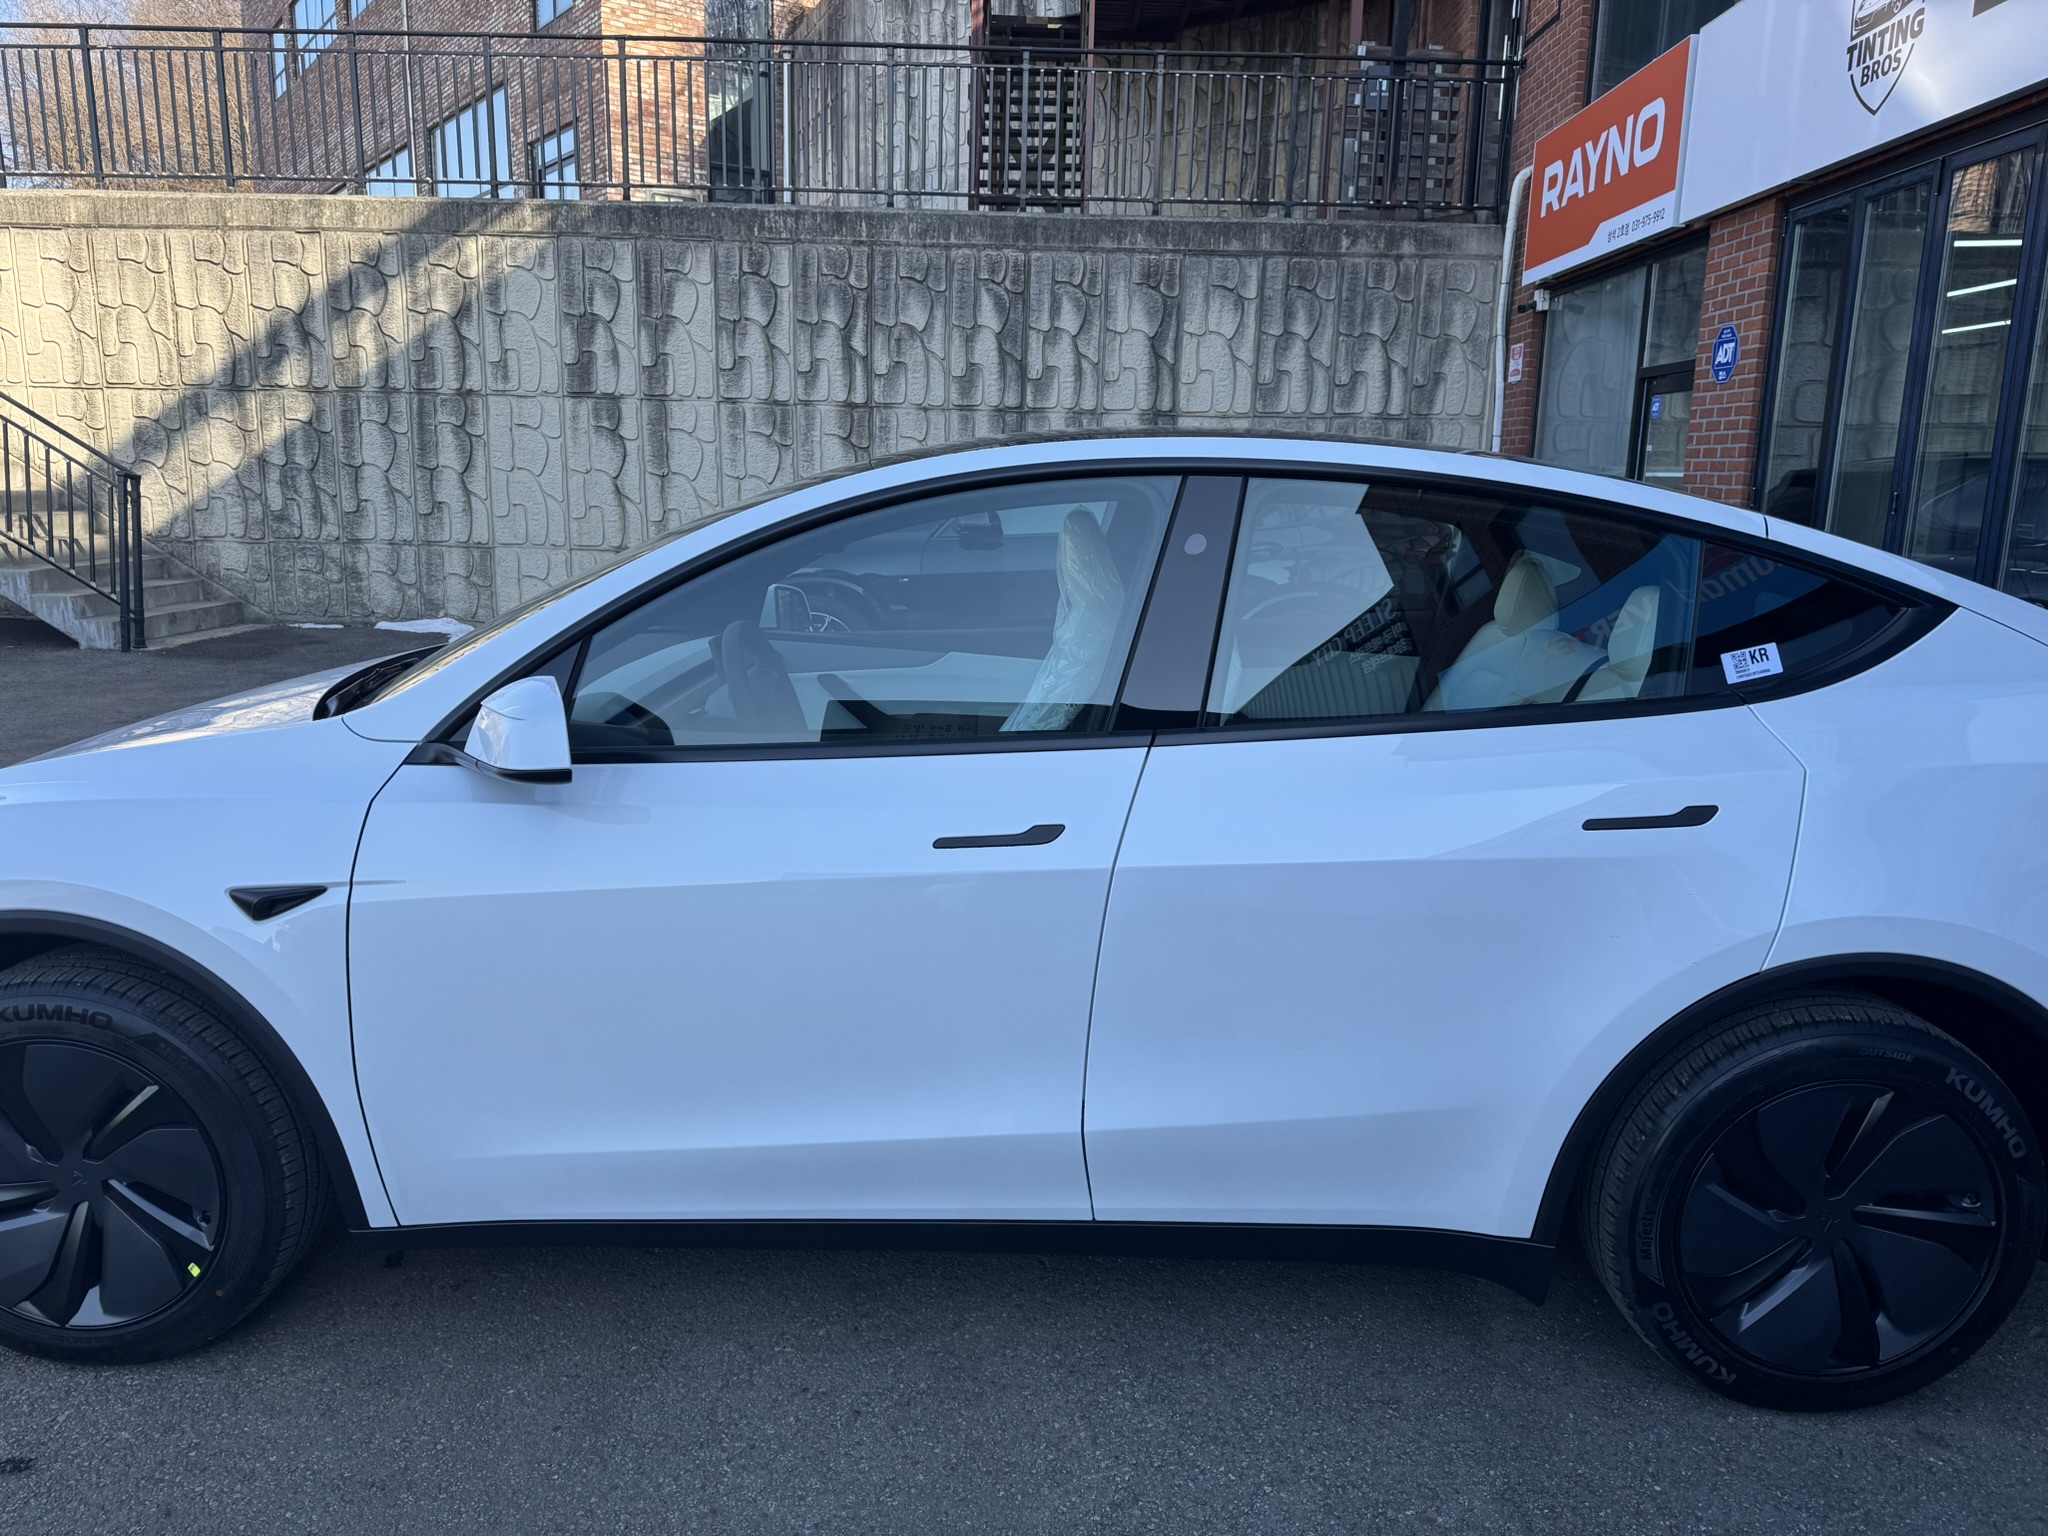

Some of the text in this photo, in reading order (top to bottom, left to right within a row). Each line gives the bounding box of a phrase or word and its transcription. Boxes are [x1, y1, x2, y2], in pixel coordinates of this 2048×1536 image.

[1846, 7, 1925, 73] TINTING
[1860, 48, 1902, 88] BROS
[1540, 97, 1666, 219] RAYNO
[1631, 207, 1666, 232] 031-975-9912
[1714, 341, 1736, 365] ADT
[1748, 646, 1770, 665] KR
[1859, 1047, 1916, 1063] OUTSIDE
[1944, 1067, 2028, 1159] KUMHO
[1652, 1301, 1738, 1386] KUMHO
